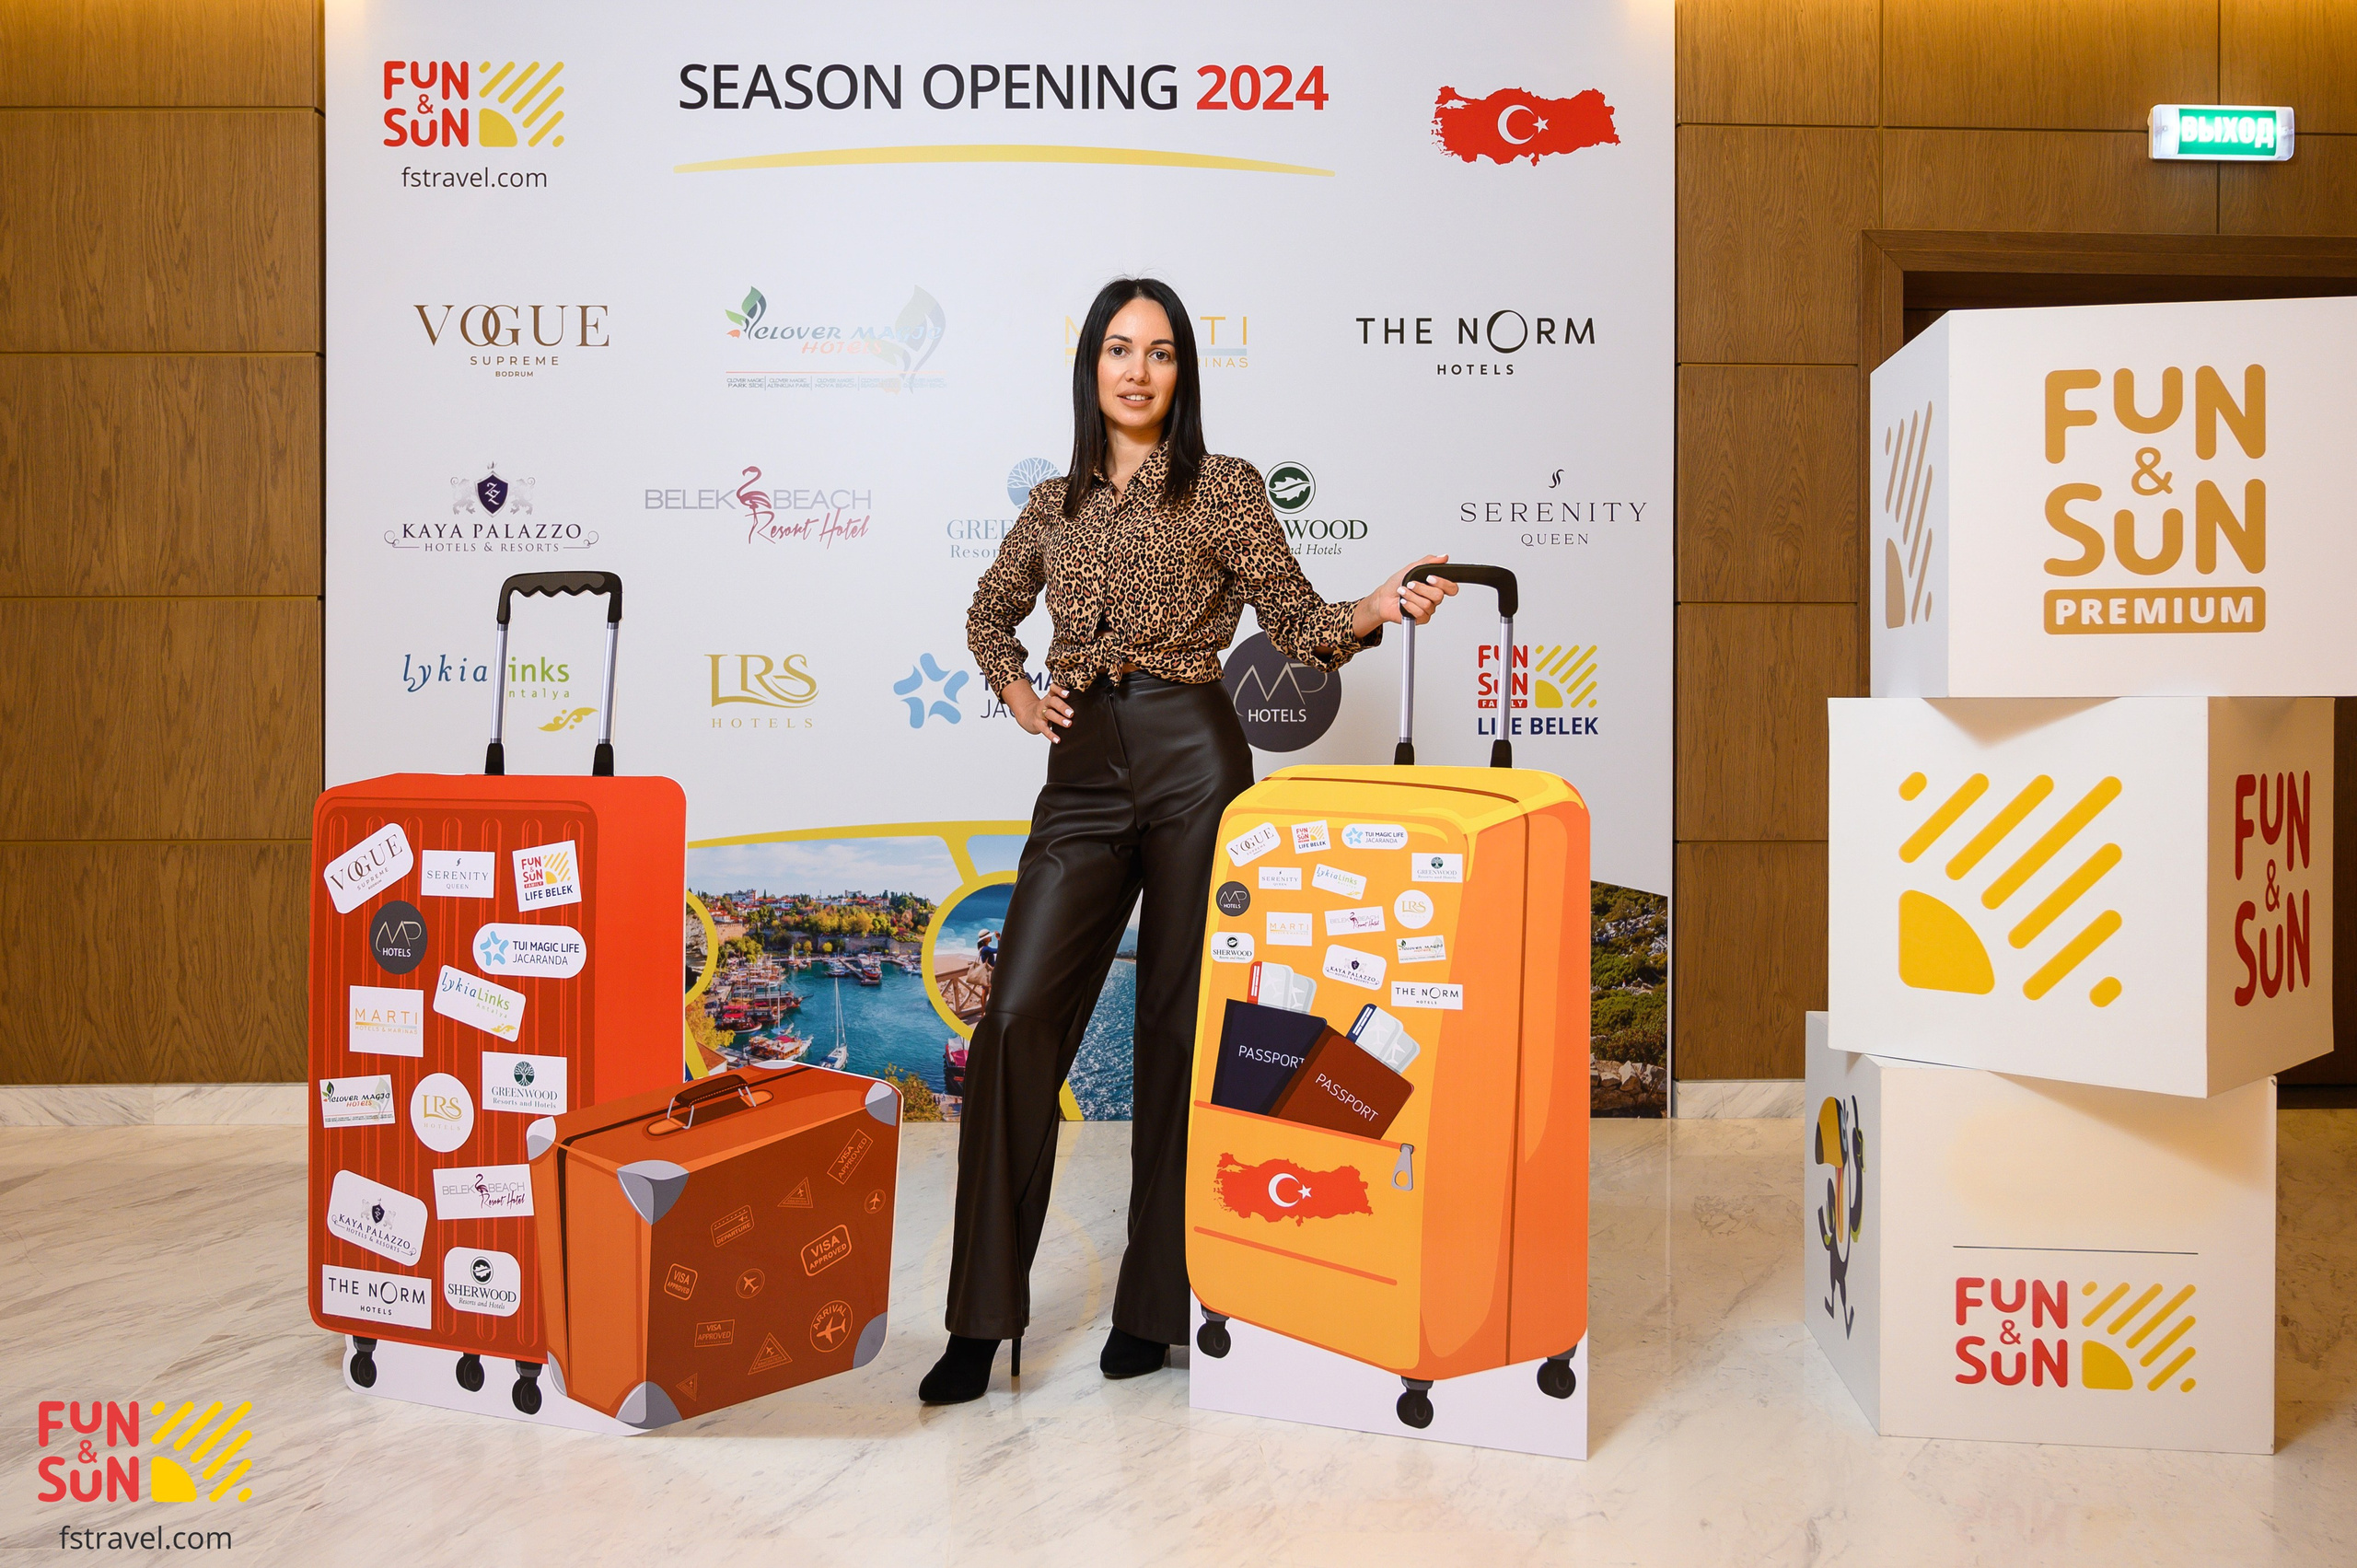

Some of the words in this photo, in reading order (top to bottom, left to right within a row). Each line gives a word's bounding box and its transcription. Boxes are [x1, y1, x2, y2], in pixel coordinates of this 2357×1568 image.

[384, 61, 469, 100] FUN
[679, 64, 901, 110] SEASON
[922, 64, 1178, 110] OPENING
[1196, 64, 1329, 110] 2024
[417, 94, 434, 114] &
[384, 108, 469, 147] SUN
[2181, 115, 2274, 148] ВЫХОД
[401, 167, 547, 188] fstravel.com
[413, 304, 610, 347] VOGUE
[755, 326, 842, 340] CLOVER
[850, 326, 942, 342] MAGIC
[1356, 318, 1432, 344] THE
[1457, 309, 1596, 354] NORM
[470, 356, 559, 366] SUPREME
[1437, 364, 1514, 375] HOTELS
[2044, 364, 2266, 464] FUN
[2131, 447, 2173, 496] &
[644, 489, 737, 509] BELEK
[773, 489, 872, 509] BEACH
[1460, 503, 1647, 522] SERENITY
[402, 524, 464, 539] KAYA
[473, 524, 582, 539] PALAZZO
[745, 510, 819, 544] Resort
[819, 507, 870, 550] Hotel
[1283, 519, 1368, 540] WOOD
[2043, 478, 2266, 577] SUN
[424, 543, 476, 552] HOTELS
[483, 542, 493, 552] &
[501, 543, 559, 552] RESORTS
[1306, 543, 1342, 555] Hotels
[1521, 533, 1589, 547] QUEEN
[2055, 596, 2254, 625] PREMIUM
[703, 654, 819, 708] LRS
[508, 689, 570, 700] ntalya
[712, 718, 813, 728] HOTELS
[1248, 709, 1306, 723] HOTELS
[1478, 717, 1522, 735] LIE
[1530, 717, 1598, 735] BELEK
[2235, 770, 2310, 880] FUN
[1230, 827, 1274, 856] VOGUE
[330, 834, 403, 890] VOGUE
[521, 856, 541, 870] FUN
[357, 867, 389, 890] SUPREME
[426, 870, 489, 881] SERENITY
[2265, 858, 2281, 912] &
[525, 890, 543, 901] LIFE
[545, 885, 574, 898] BELEK
[382, 947, 412, 958] HOTELS
[513, 940, 528, 951] TUI
[529, 941, 559, 953] MAGIC
[561, 943, 580, 954] LIFE
[2235, 889, 2310, 1006] SUN
[513, 953, 568, 966] JACARANDA
[1330, 966, 1346, 975] KAYA
[1348, 971, 1376, 982] PALAZZO
[1395, 987, 1416, 996] THE
[1422, 987, 1459, 999] NORM
[354, 1007, 418, 1025] MARTI
[491, 1086, 558, 1101] GREENWOOD
[493, 1097, 518, 1106] Resorts
[1315, 1073, 1379, 1122] PASSPORT
[422, 1094, 463, 1122] LRS
[424, 1122, 461, 1131] HOTELS
[838, 1145, 854, 1165] VISA
[838, 1137, 867, 1179] APPROVED
[442, 1184, 475, 1195] BELEK
[488, 1182, 526, 1193] BEACH
[339, 1214, 363, 1231] KAYA
[366, 1225, 411, 1249] PALAZZO
[716, 1222, 751, 1245] DEPARTURE
[810, 1235, 841, 1258] VISA
[809, 1243, 847, 1271] APPROVED
[673, 1270, 691, 1285] VISA
[329, 1277, 359, 1295] THE
[368, 1281, 425, 1305] NORM
[447, 1283, 517, 1303] SHERWOOD
[667, 1281, 691, 1295] APPROVED
[360, 1305, 392, 1316] HOTELS
[1955, 1277, 2068, 1330] FUN
[706, 1323, 722, 1331] VISA
[813, 1304, 847, 1330] ARRIVAL
[697, 1330, 731, 1341] APPROVED
[1999, 1319, 2021, 1345] &
[1955, 1336, 2068, 1388] SUN
